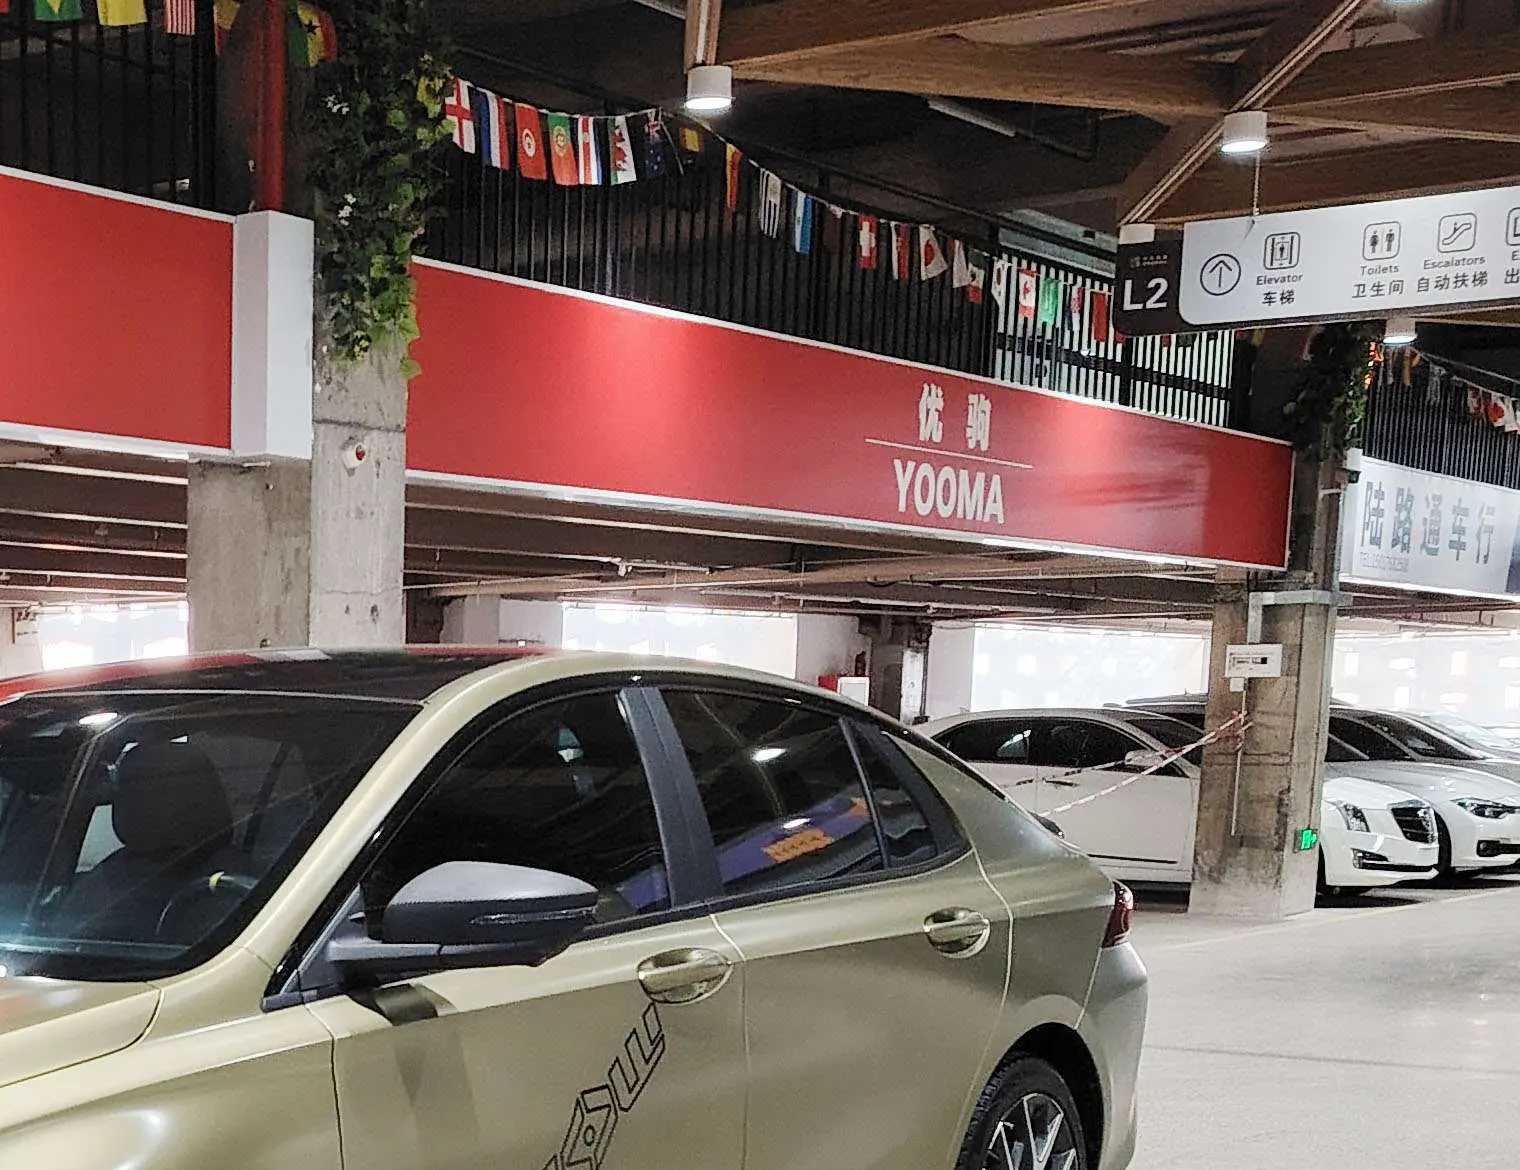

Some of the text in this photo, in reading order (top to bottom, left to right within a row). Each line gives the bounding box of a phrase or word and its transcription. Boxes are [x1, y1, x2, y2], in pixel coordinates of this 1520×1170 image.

[1360, 264, 1399, 276] Toilets
[1423, 256, 1486, 270] Escalators
[1256, 274, 1303, 286] Elevator
[1351, 279, 1404, 298] 卫生间
[1417, 270, 1489, 293] 自动扶梯
[1123, 277, 1168, 311] L2
[1262, 289, 1295, 306] 车梯
[893, 458, 1005, 525] YOOMA
